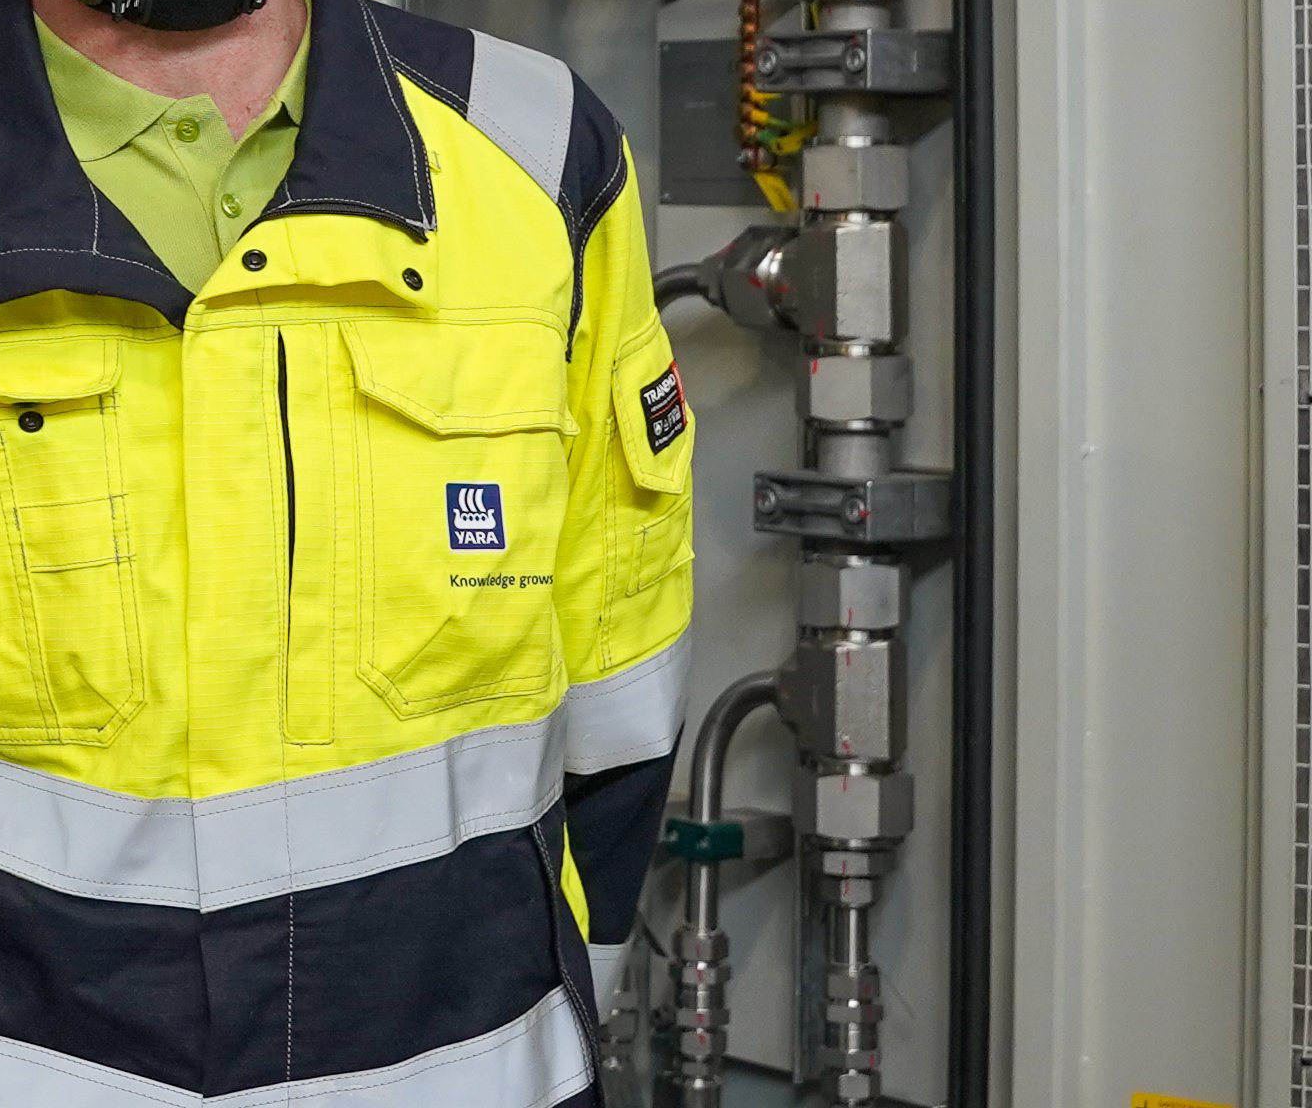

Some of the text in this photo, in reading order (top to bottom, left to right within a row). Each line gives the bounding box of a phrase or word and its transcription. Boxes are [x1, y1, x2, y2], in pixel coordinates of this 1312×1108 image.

[454, 531, 499, 545] YARA
[450, 573, 554, 589] Knowledge grows
